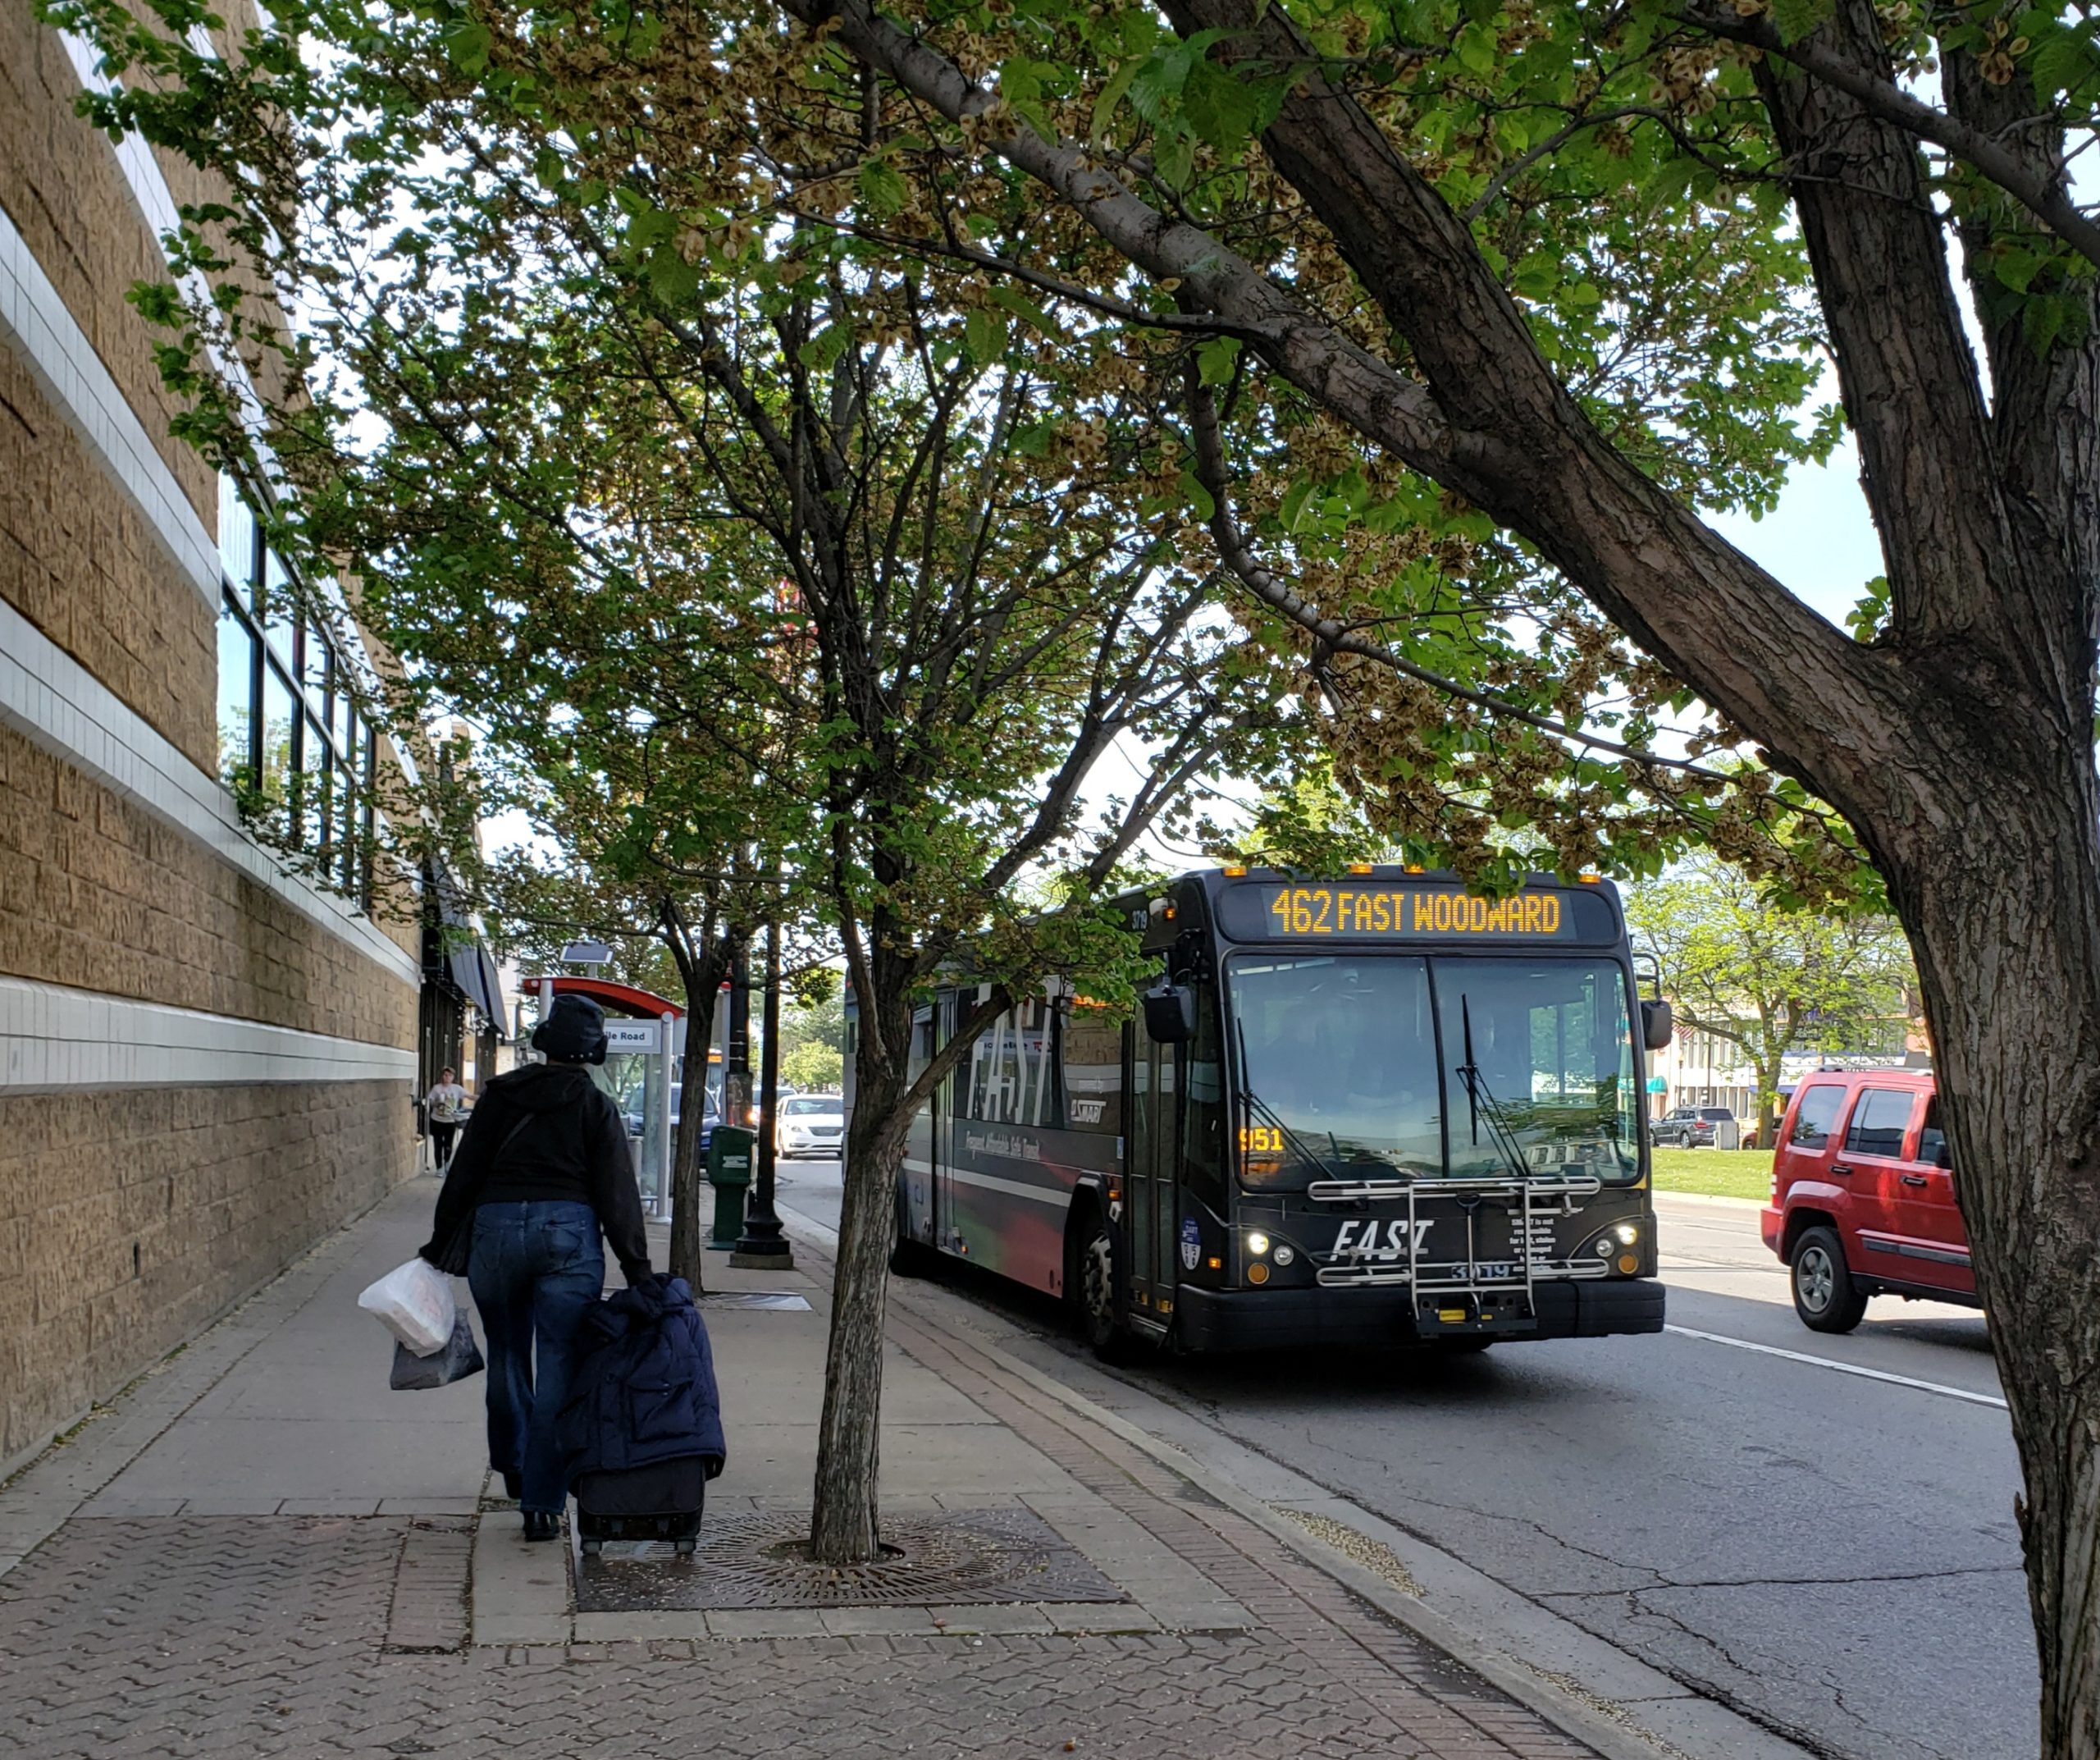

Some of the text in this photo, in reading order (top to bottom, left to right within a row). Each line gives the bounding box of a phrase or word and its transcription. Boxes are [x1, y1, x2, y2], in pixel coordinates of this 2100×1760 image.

[1271, 889, 1560, 933] 462 FAST WOODWARD
[620, 1031, 646, 1040] Road
[1239, 1127, 1283, 1150] 951
[1330, 1219, 1435, 1262] FAST
